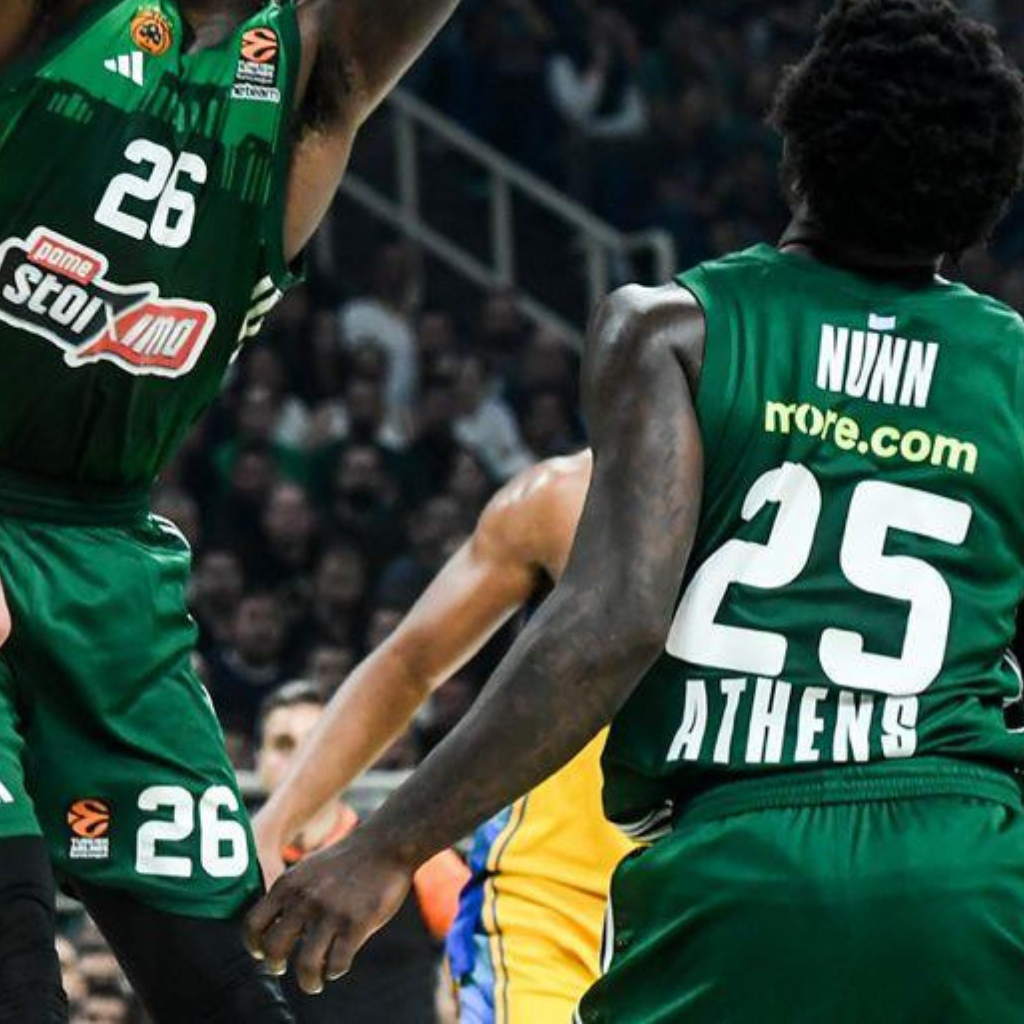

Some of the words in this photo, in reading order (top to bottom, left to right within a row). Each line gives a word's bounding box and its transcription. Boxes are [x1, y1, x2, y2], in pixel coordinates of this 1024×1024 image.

[94, 137, 208, 248] 26
[815, 324, 938, 409] NUNN
[764, 398, 978, 474] more.com
[665, 461, 973, 696] 25
[666, 677, 918, 764] ATHENS
[135, 785, 249, 878] 26
